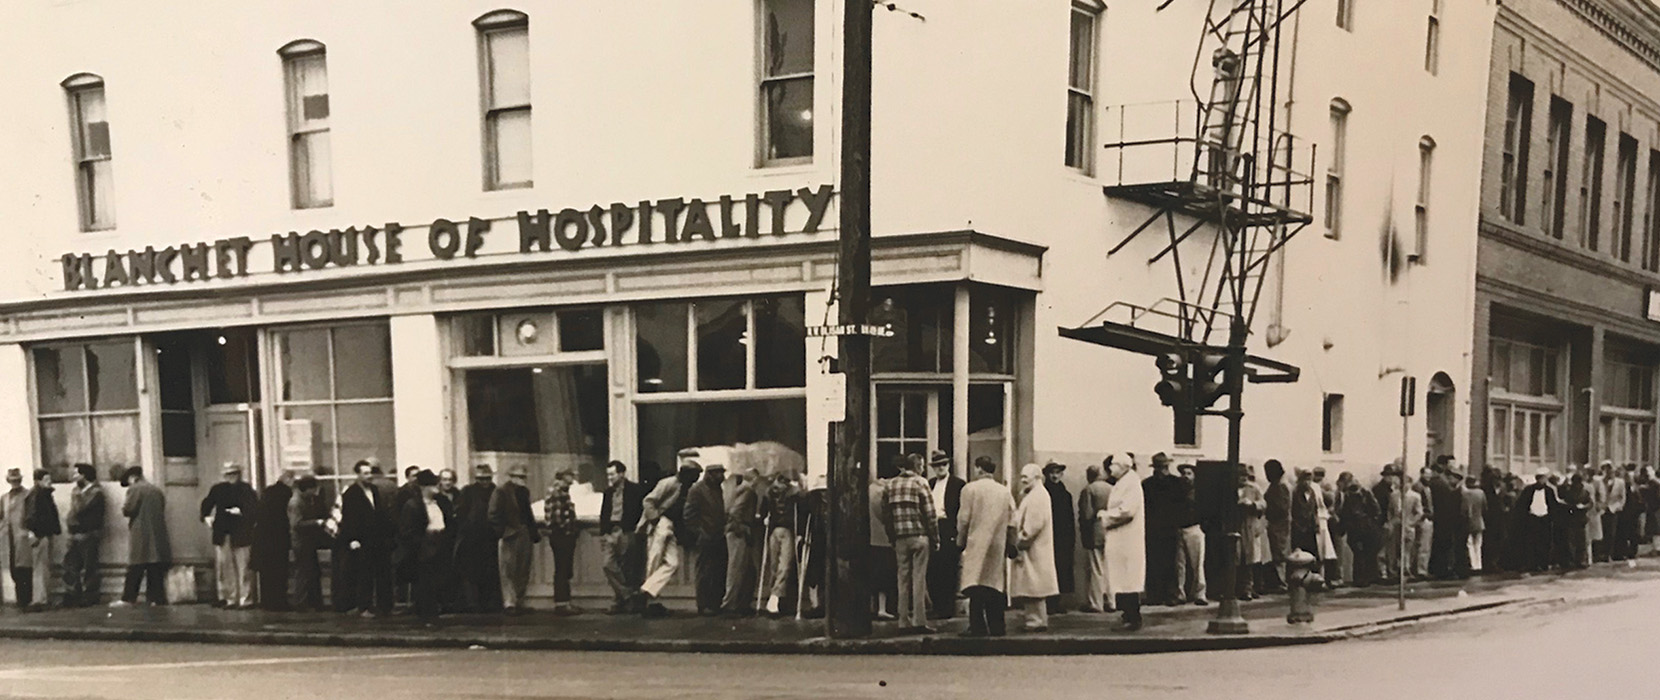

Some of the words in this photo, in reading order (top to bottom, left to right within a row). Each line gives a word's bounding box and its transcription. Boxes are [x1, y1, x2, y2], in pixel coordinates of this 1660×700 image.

[62, 236, 250, 291] BLANCHET
[272, 222, 402, 274] HOUSE
[428, 217, 491, 259] OF
[517, 185, 834, 253] HOSPITALITY
